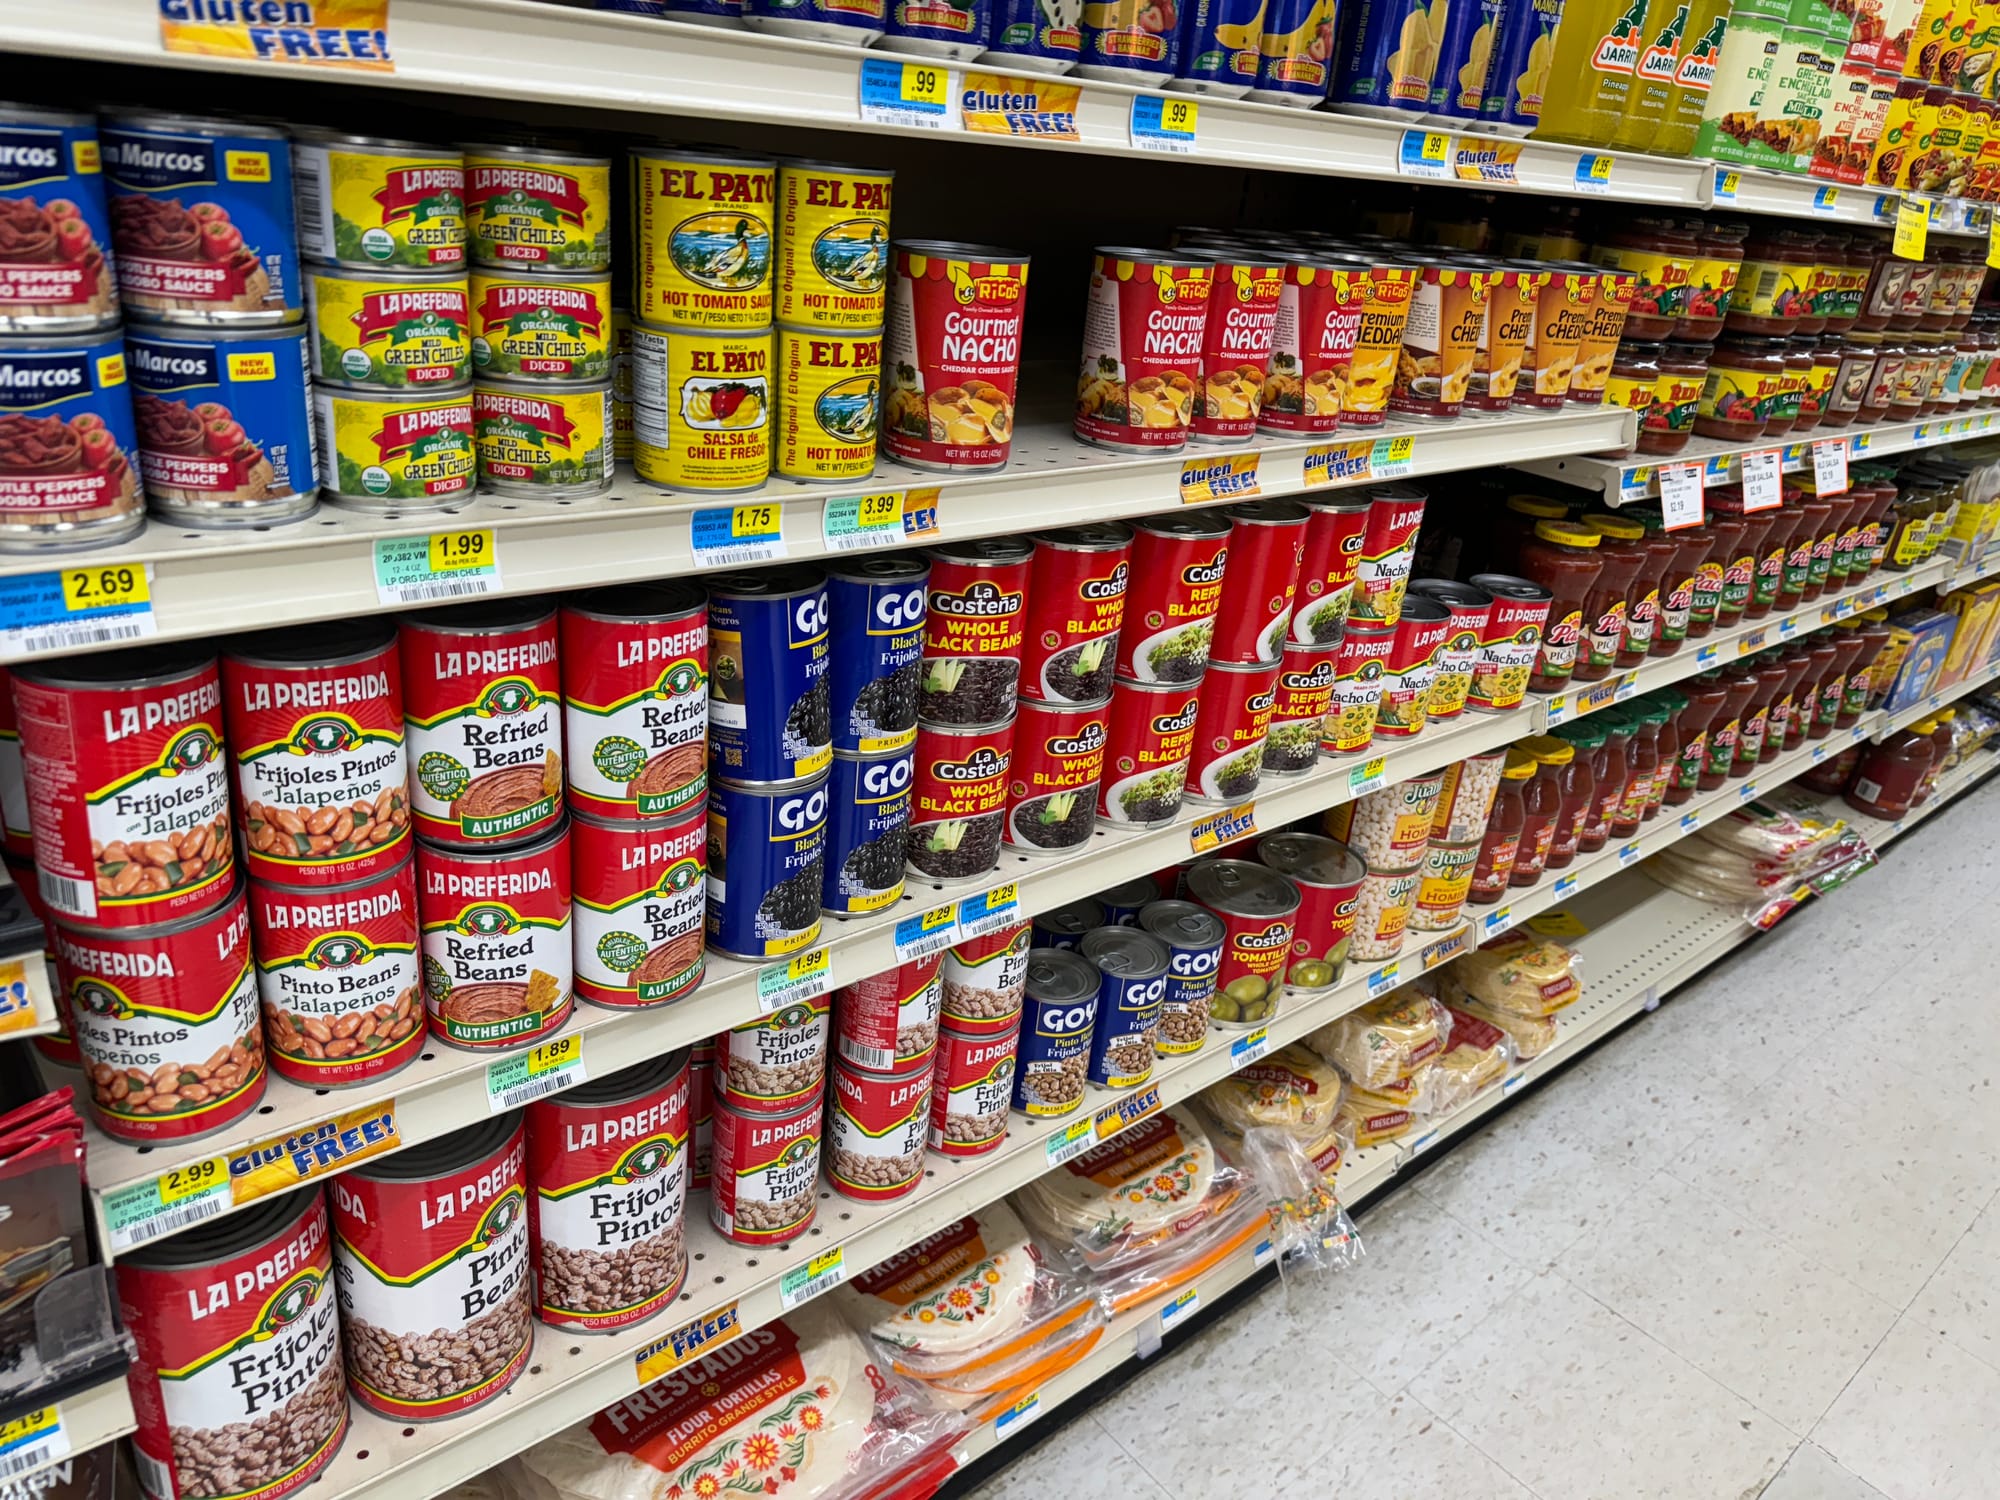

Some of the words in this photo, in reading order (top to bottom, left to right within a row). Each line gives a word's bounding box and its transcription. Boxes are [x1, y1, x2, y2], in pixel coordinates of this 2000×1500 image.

[159, 0, 314, 26] Gluten
[248, 28, 392, 61] FREE!
[911, 70, 936, 94] .99
[962, 90, 1037, 114] Gluten
[1167, 102, 1187, 124] .99
[1005, 112, 1079, 137] FREE!
[1426, 136, 1441, 154] .99
[121, 143, 206, 173] Marcos
[237, 156, 261, 168] NEW
[1456, 149, 1498, 166] Gluten
[232, 166, 267, 178] IMAGE
[475, 169, 491, 188] LA
[492, 169, 567, 198] PREFERIDA
[1480, 163, 1517, 183] FREE!
[659, 168, 704, 200] EL
[806, 178, 848, 209] EL
[494, 204, 545, 218] ORGANIC
[713, 201, 749, 211] BRAND
[477, 223, 518, 242] GREEN
[520, 227, 567, 245] CHILES
[509, 217, 532, 228] MILD
[502, 245, 541, 260] DICED
[151, 264, 226, 282] PEPPERS
[644, 241, 655, 289] Original
[163, 278, 215, 294] SAUCE
[498, 288, 515, 307] LA
[517, 287, 588, 311] PREFERIDA
[662, 290, 691, 307] HOT
[692, 292, 749, 310] TOMATO
[519, 320, 570, 333] ORGANIC
[944, 311, 1020, 337] Gourmet
[501, 338, 541, 356] GREEN
[542, 341, 587, 358] CHILES
[942, 335, 1017, 363] NACHO
[136, 352, 208, 376] Marcos
[235, 366, 271, 377] IMAGE
[239, 359, 265, 370] NEW
[528, 359, 567, 372] DICED
[691, 351, 723, 372] EL
[723, 350, 767, 373] PATO
[941, 364, 977, 374] CHEDDAR
[978, 365, 1001, 375] CHEESE
[703, 432, 744, 447] SALSA
[746, 431, 759, 445] de
[1391, 437, 1411, 453] 3.99
[687, 446, 729, 461] CHILE
[730, 444, 767, 460] FRESCO
[945, 449, 958, 458] NET
[1304, 449, 1348, 469] Gluten
[167, 460, 229, 474] PEPPERS
[169, 470, 219, 486] SAUCE
[1181, 463, 1231, 485] Gluten
[1327, 456, 1368, 480] FREE!
[432, 478, 464, 493] DICED
[1208, 471, 1257, 496] FREE!
[864, 496, 894, 516] 3.99
[736, 507, 771, 529] 1.75
[439, 534, 484, 557] 1.99
[1374, 564, 1408, 577] Nacho
[72, 567, 135, 598] 2.69
[973, 585, 993, 600] La
[936, 594, 1019, 615] Costeña
[946, 620, 1010, 636] WHOLE
[1066, 618, 1114, 634] BLACK
[978, 630, 1022, 652] BEANS
[434, 651, 462, 680] LA
[466, 637, 557, 676] PREFERIDA
[880, 648, 920, 668] Frijoles
[243, 682, 271, 713] LA
[276, 671, 390, 708] PREFERIDA
[1434, 703, 1459, 714] ZESTY
[462, 711, 550, 747] Refried
[877, 735, 906, 747] PRIME
[472, 742, 545, 769] Beans
[975, 751, 992, 765] La
[1366, 758, 1384, 772] 3.29
[253, 762, 338, 787] Frijoles
[341, 751, 398, 780] Pintos
[939, 755, 1010, 780] Costeña
[274, 778, 383, 807] Jalapeños
[949, 777, 1003, 799] WHOLE
[920, 796, 975, 814] BLACK
[472, 801, 550, 835] AUTHENTIC
[1191, 812, 1233, 839] Gluten
[1216, 815, 1255, 843] FREE!
[299, 867, 318, 876] PESO
[318, 865, 336, 875] NETO
[426, 870, 446, 895] LA
[448, 867, 552, 897] PREFERIDA
[991, 884, 1015, 902] 2.29
[265, 902, 289, 929] LA
[295, 889, 403, 928] PREFERIDA
[925, 905, 951, 924] 2.29
[445, 936, 535, 961] Refried
[454, 961, 528, 982] Beans
[795, 951, 823, 971] 1.99
[279, 973, 335, 995] Pinto
[338, 962, 401, 992] Beans
[290, 983, 397, 1016] Jalapeños
[454, 1017, 534, 1038] AUTHENTIC
[755, 1022, 821, 1049] Frijoles
[534, 1039, 571, 1062] 1.89
[759, 1041, 817, 1065] Pintos
[1120, 1088, 1161, 1125] FREE!
[229, 1121, 338, 1178] Gluten
[290, 1113, 395, 1178] FREE!
[566, 1124, 598, 1152] LA
[168, 1160, 216, 1190] 2.99
[589, 1164, 684, 1219] Frijoles
[596, 1194, 682, 1246] Pintos
[468, 1226, 526, 1288] Pinto
[188, 1279, 230, 1321] LA
[228, 1293, 335, 1389] Frijoles
[673, 1308, 738, 1359] FREE!
[241, 1328, 336, 1416] Pintos
[605, 1322, 777, 1434] FRESCADOS
[864, 1364, 887, 1391] 8
[665, 1404, 713, 1446] FLOUR
[714, 1368, 783, 1415] TORTILLAS
[667, 1424, 718, 1465] BURRITO
[718, 1396, 763, 1437] GRANDE
[763, 1374, 798, 1403] STYLE
